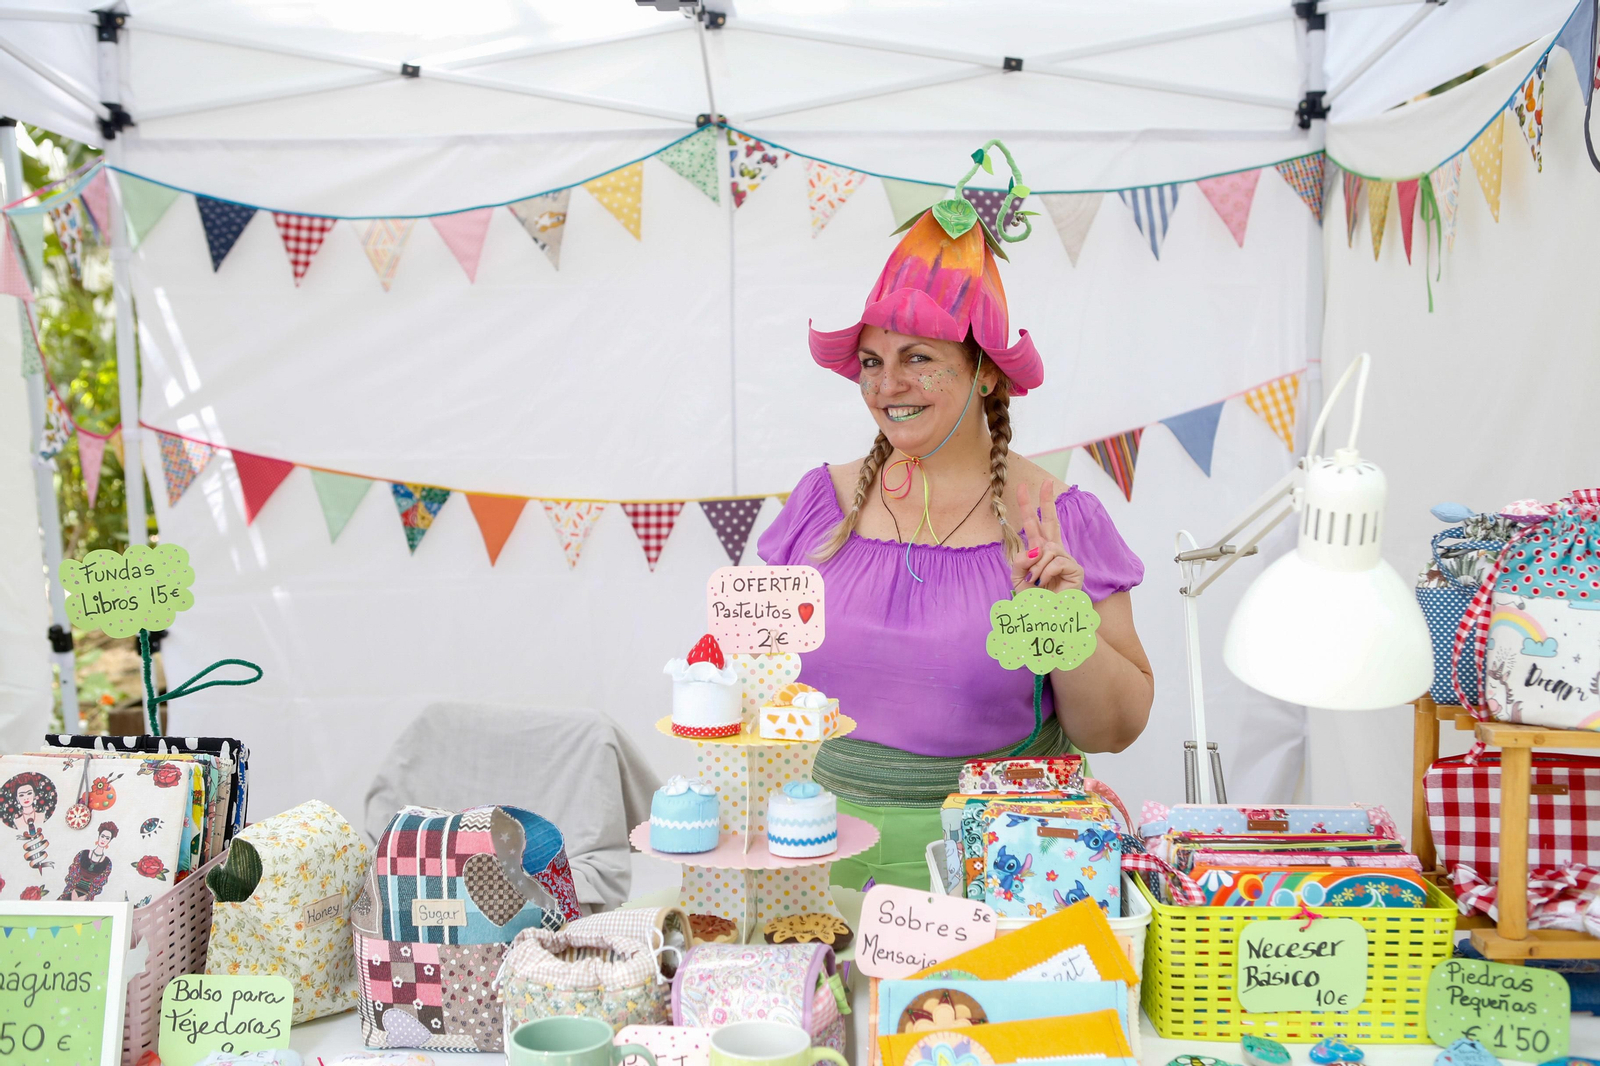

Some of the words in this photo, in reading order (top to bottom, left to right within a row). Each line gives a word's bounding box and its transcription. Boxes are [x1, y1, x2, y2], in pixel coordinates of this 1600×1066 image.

[79, 558, 156, 584] Fundas
[80, 591, 140, 617] Libros
[1030, 636, 1065, 657] 10€
[1524, 662, 1588, 702] Dream
[306, 903, 340, 924] Honey
[418, 904, 460, 925] Sugar
[878, 900, 968, 942] Sobres
[972, 908, 992, 923] 5€
[1246, 937, 1346, 959] Neceser
[1445, 961, 1534, 993] Piedras
[171, 979, 223, 1003] Bolso
[231, 988, 286, 1016] para
[1445, 985, 1538, 1018] Pequeñas
